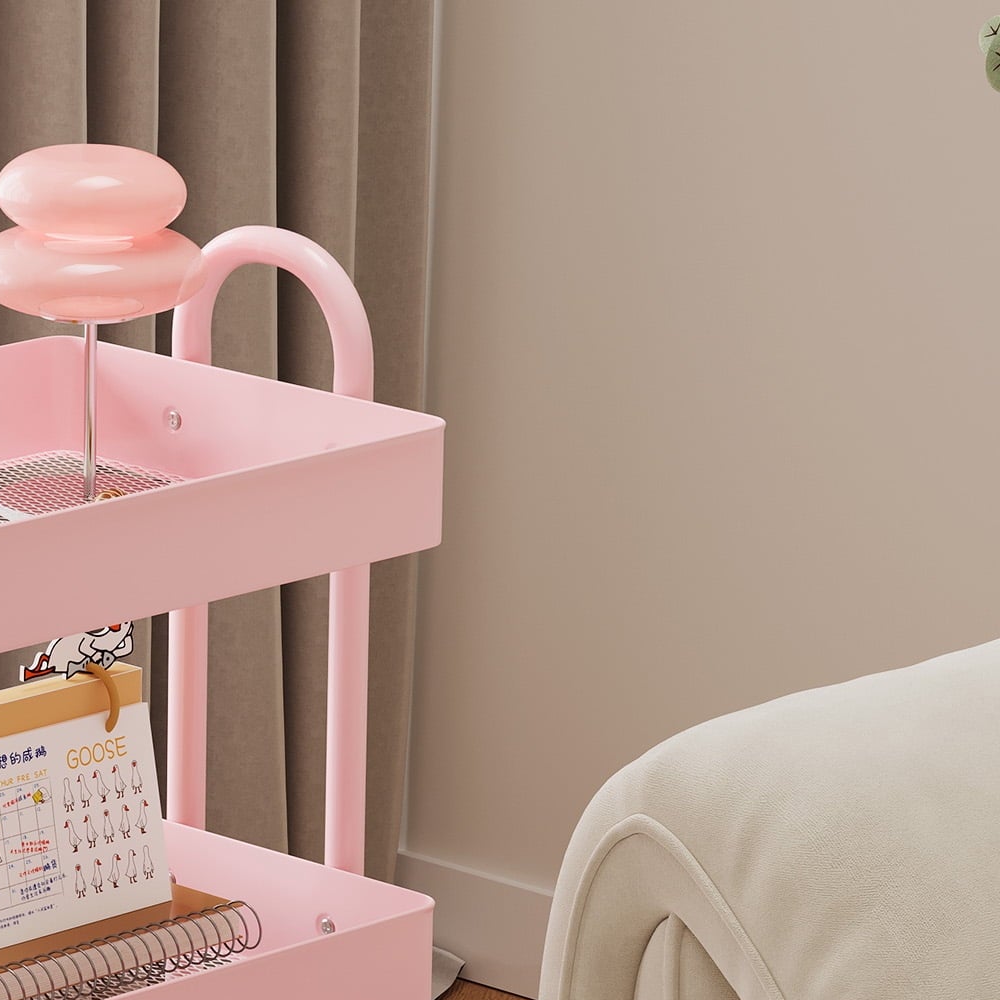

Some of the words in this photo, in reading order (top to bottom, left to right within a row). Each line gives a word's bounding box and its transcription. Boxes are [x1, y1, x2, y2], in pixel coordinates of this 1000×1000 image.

[67, 736, 127, 769] GOOSE
[16, 773, 30, 782] FRE
[34, 769, 47, 779] SAT
